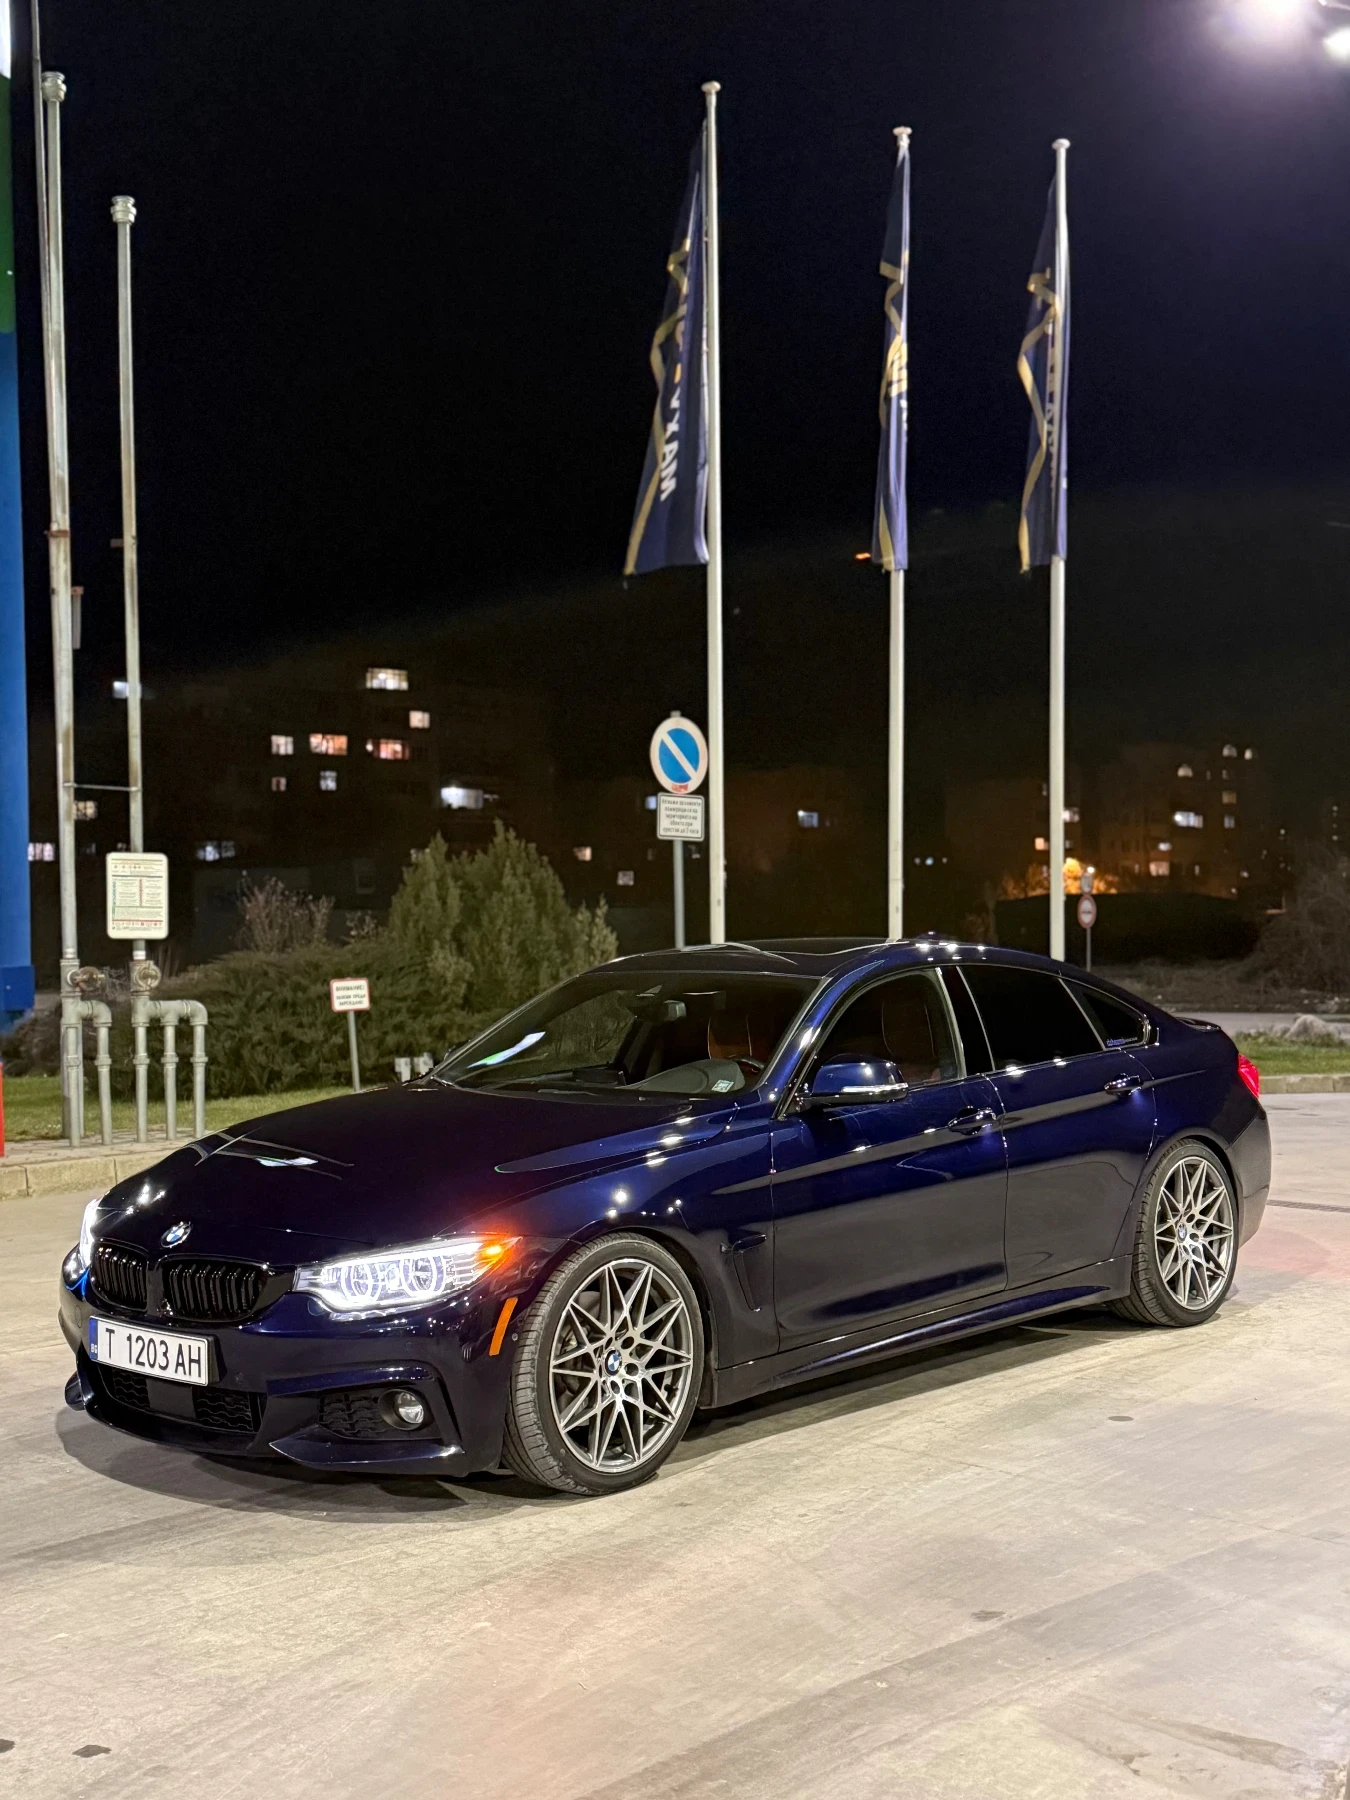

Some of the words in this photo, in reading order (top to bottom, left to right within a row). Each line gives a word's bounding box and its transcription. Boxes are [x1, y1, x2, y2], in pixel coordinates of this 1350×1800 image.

[105, 1327, 116, 1360] T
[126, 1333, 169, 1371] 1203
[174, 1343, 202, 1378] AH
